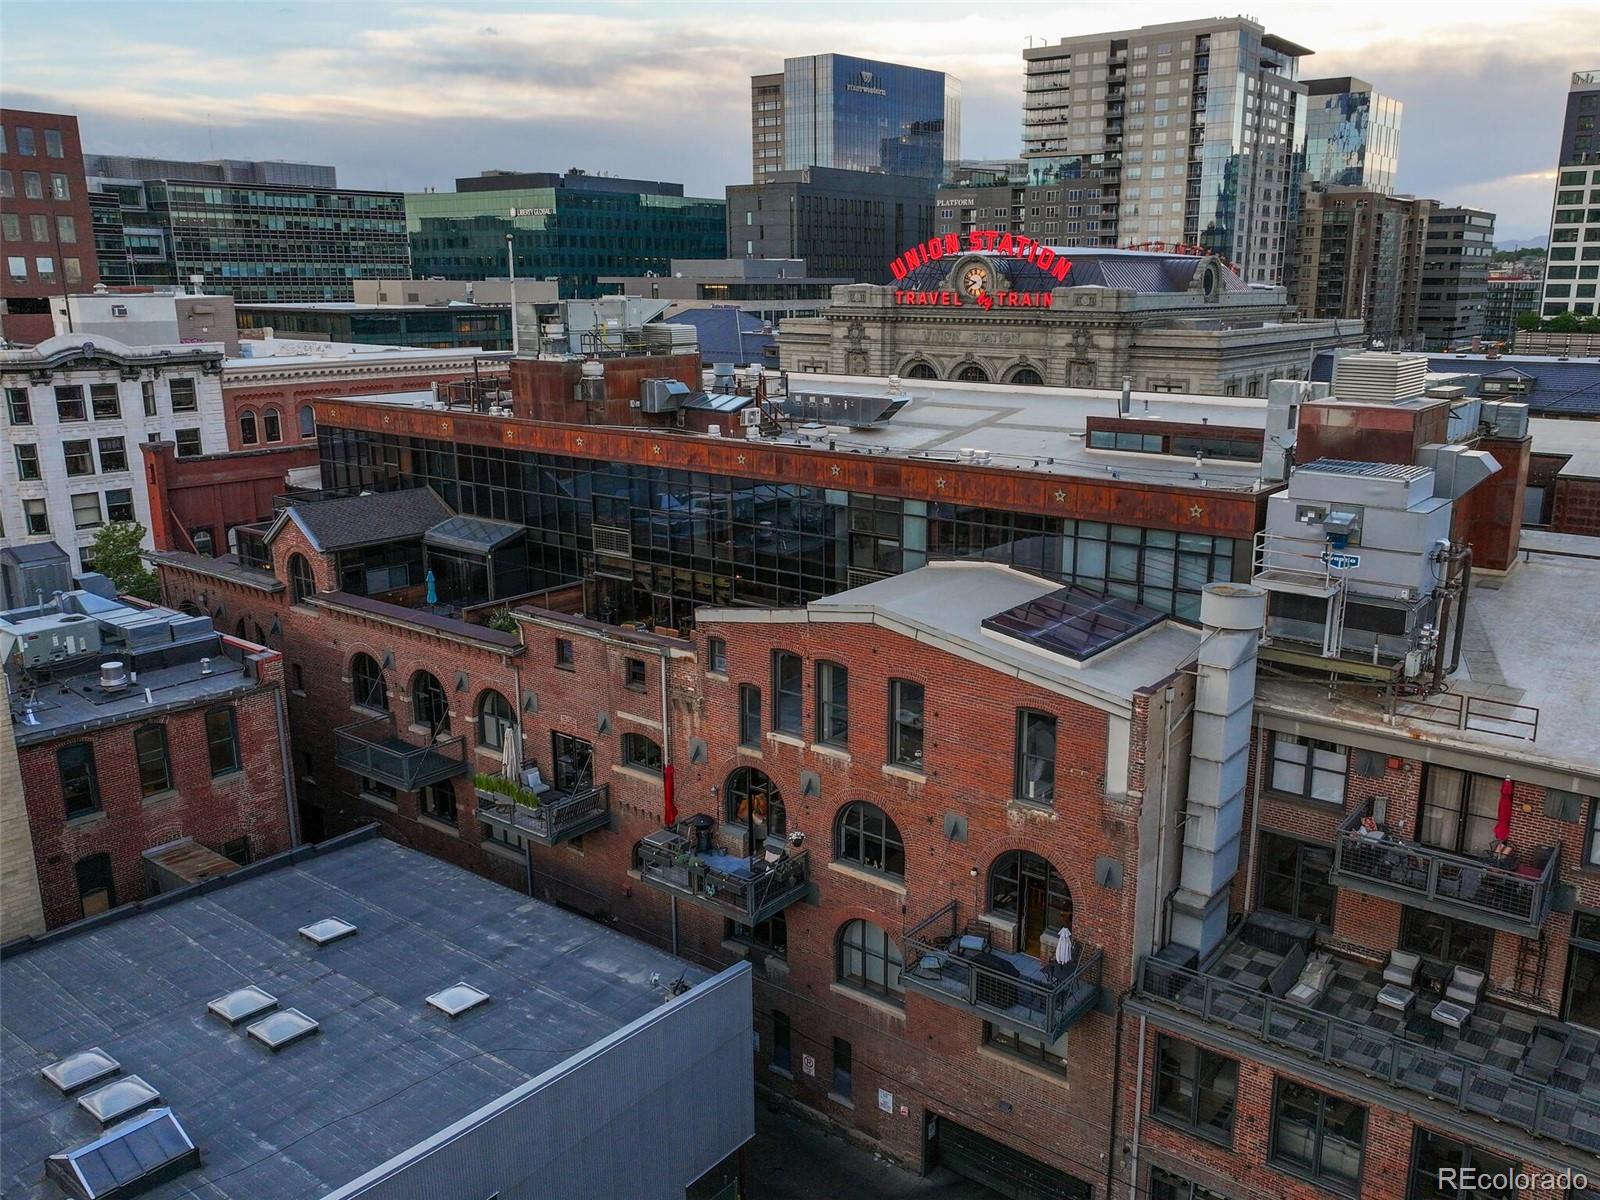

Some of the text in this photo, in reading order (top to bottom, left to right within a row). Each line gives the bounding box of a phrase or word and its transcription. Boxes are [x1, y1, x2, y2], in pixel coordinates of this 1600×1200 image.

[936, 199, 975, 207] PLATFORM
[517, 208, 534, 216] LIBERTY
[890, 233, 960, 280] UNION
[969, 230, 1073, 282] STATION
[895, 290, 1055, 311] TRAVEL by TRAIN
